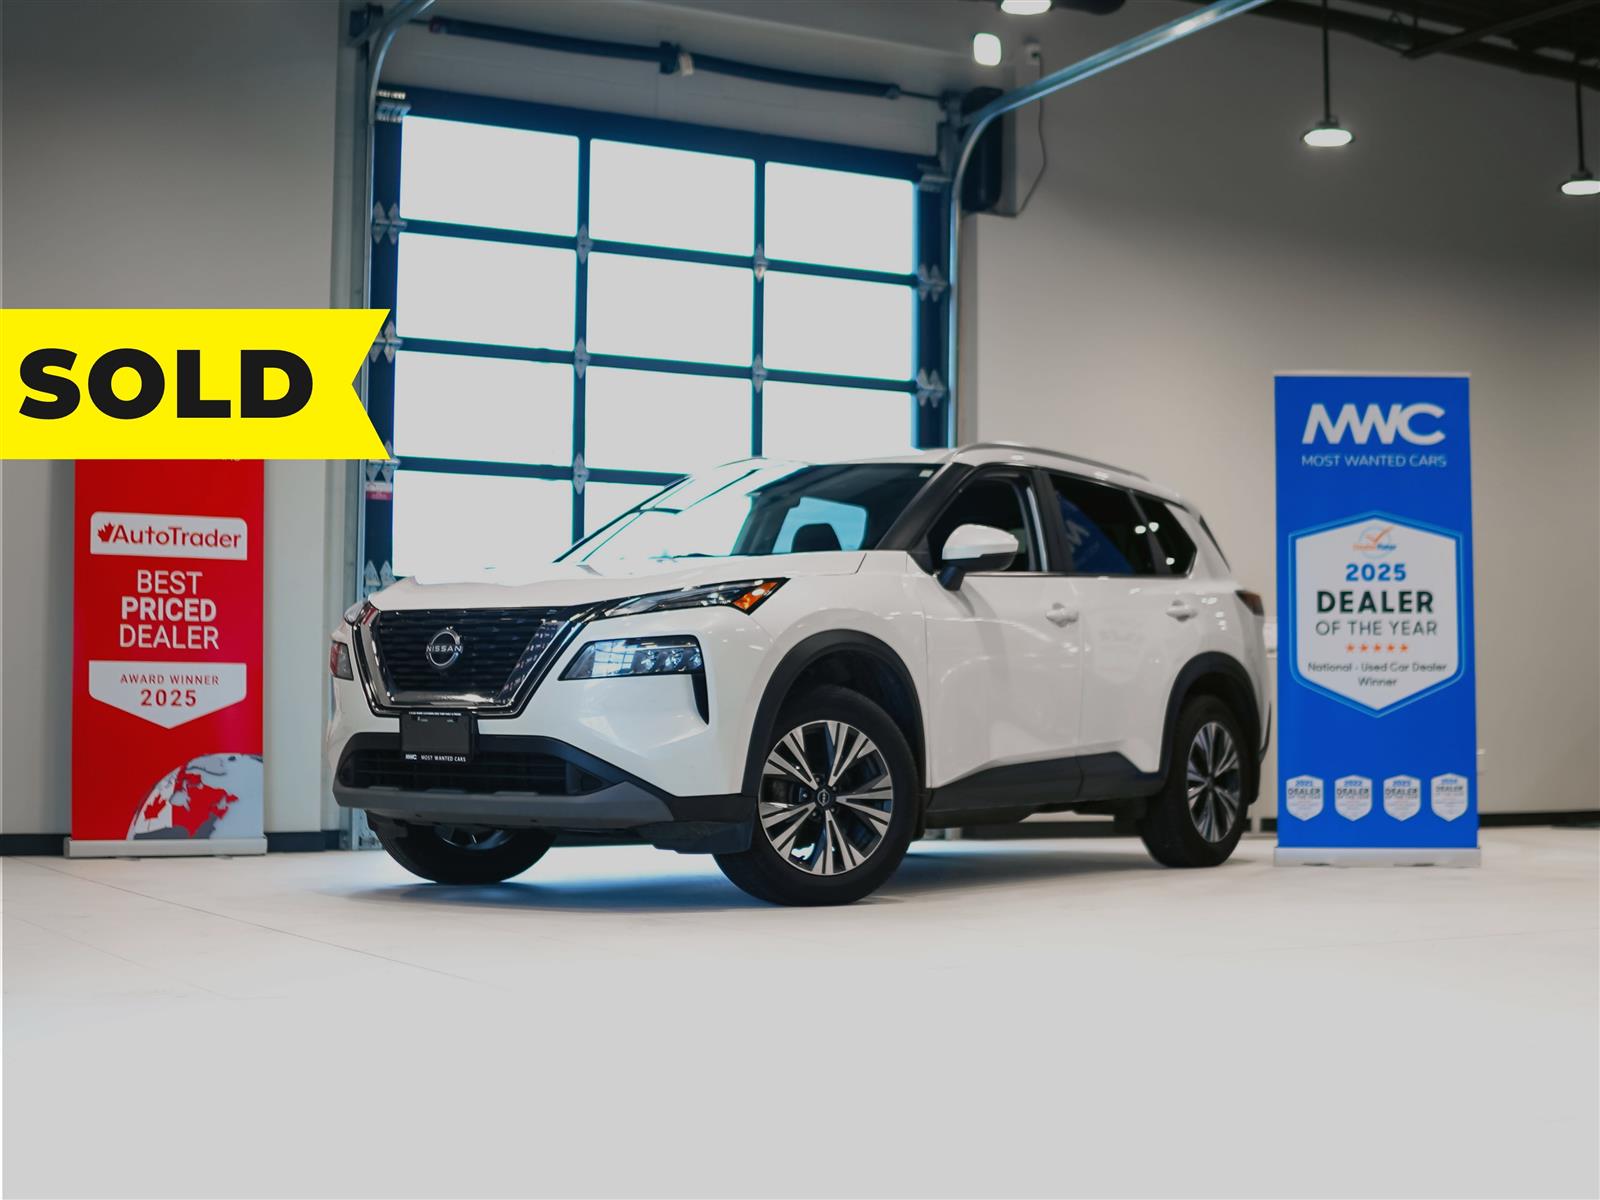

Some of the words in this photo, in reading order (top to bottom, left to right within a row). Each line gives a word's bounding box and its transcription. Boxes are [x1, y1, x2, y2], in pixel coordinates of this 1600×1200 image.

[1302, 403, 1446, 446] MWC
[1301, 455, 1340, 467] MOST
[1344, 455, 1406, 467] WANTED
[1409, 455, 1447, 467] CARS
[112, 524, 241, 548] AutoTrader
[1345, 563, 1407, 582] 2025
[137, 569, 203, 595] BEST
[121, 596, 217, 622] PRICED
[1316, 590, 1434, 614] DEALER
[119, 623, 219, 650] DEALER
[1315, 620, 1341, 636] OF
[1348, 620, 1382, 636] THE
[1388, 620, 1438, 636] YEAR
[426, 644, 462, 653] NISSAN
[1308, 663, 1352, 673] National
[1361, 663, 1387, 673] Used
[1389, 663, 1410, 673] Car
[1412, 663, 1447, 673] Dealer
[120, 673, 164, 685] AWARD
[170, 674, 219, 686] WINNER
[1358, 676, 1397, 687] Winner
[140, 689, 197, 707] 2025
